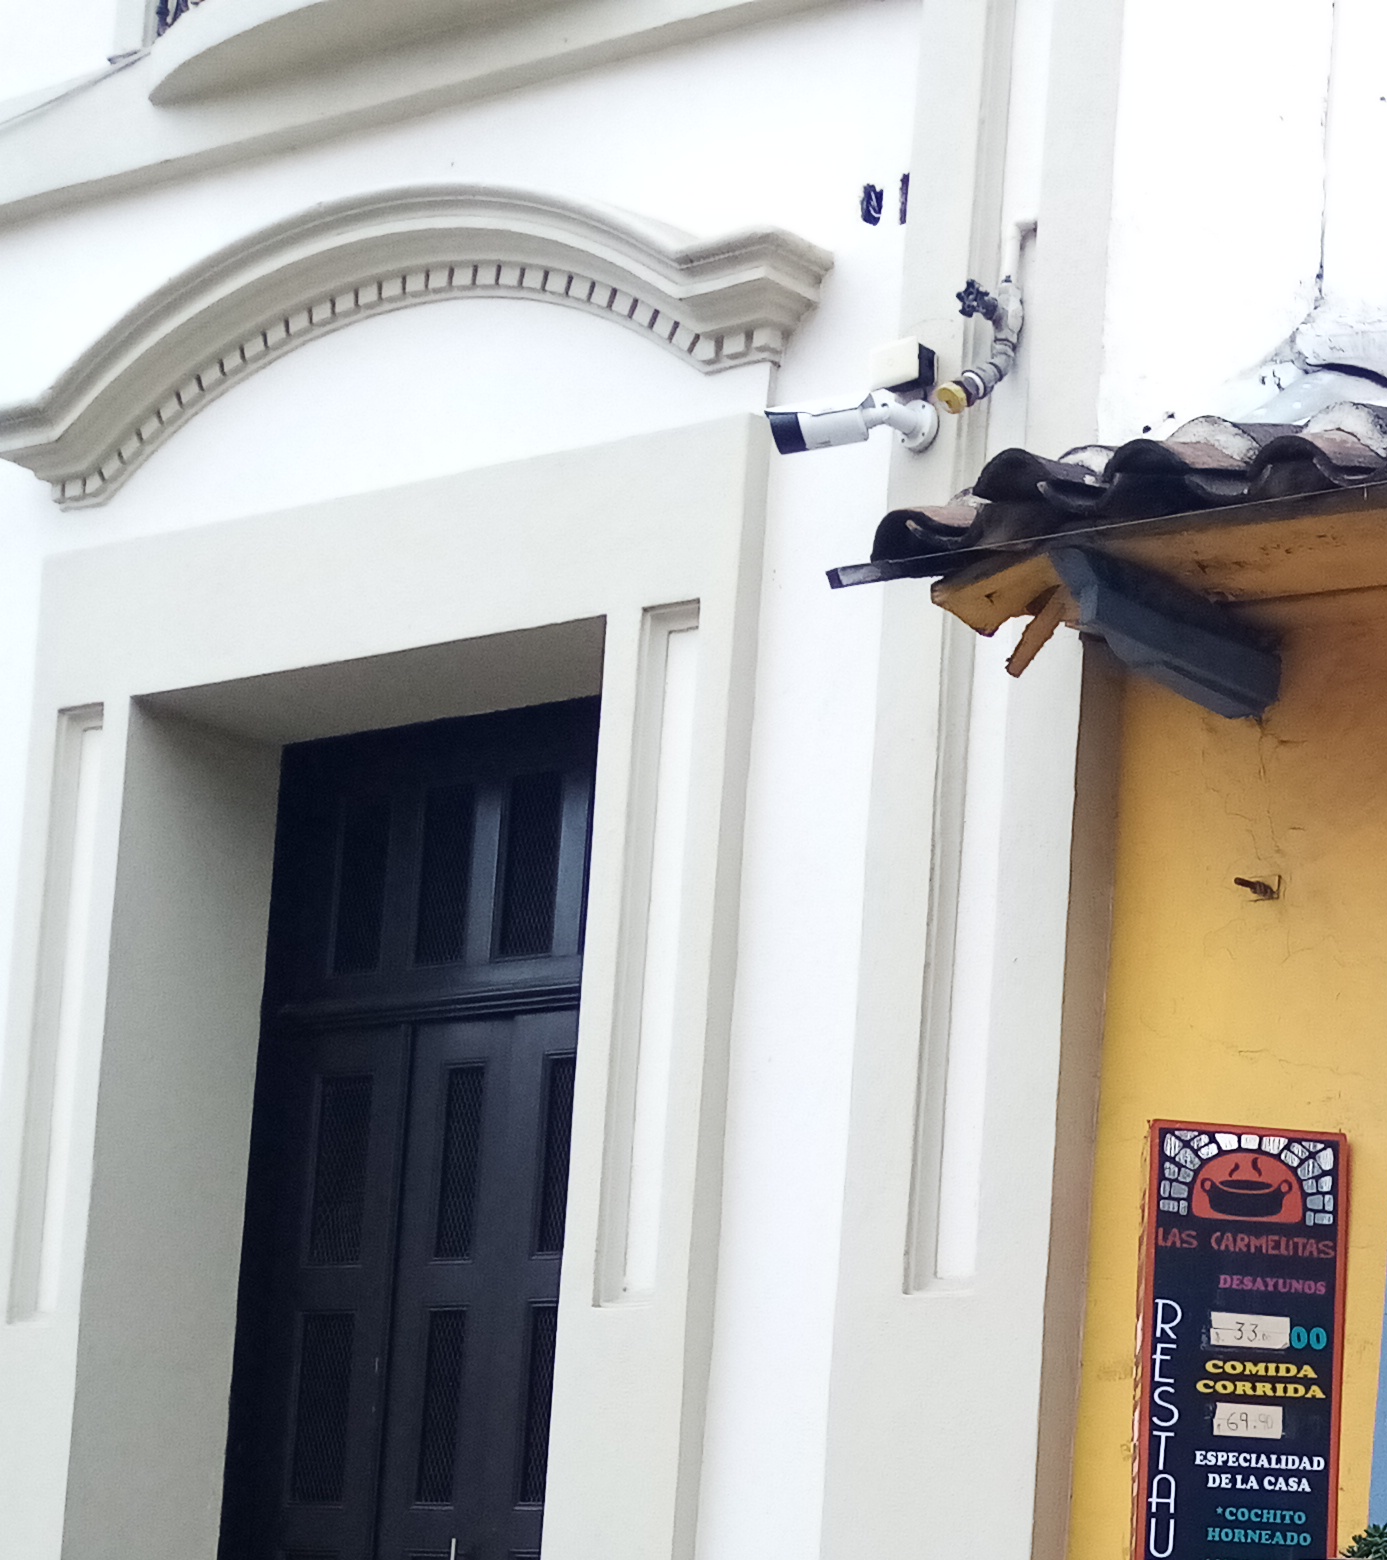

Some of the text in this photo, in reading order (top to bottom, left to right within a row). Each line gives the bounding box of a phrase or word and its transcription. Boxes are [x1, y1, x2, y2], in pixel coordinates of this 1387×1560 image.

[1157, 1227, 1335, 1258] LAS CARMELITAS
[1218, 1275, 1328, 1295] DESAYUNOS
[1204, 1360, 1318, 1379] COMIDA
[1195, 1380, 1327, 1399] CORRIDA
[1194, 1450, 1325, 1471] ESPECIALIDAD
[1206, 1473, 1312, 1493] DE LA CASA
[1206, 1527, 1312, 1546] HORNEADO
